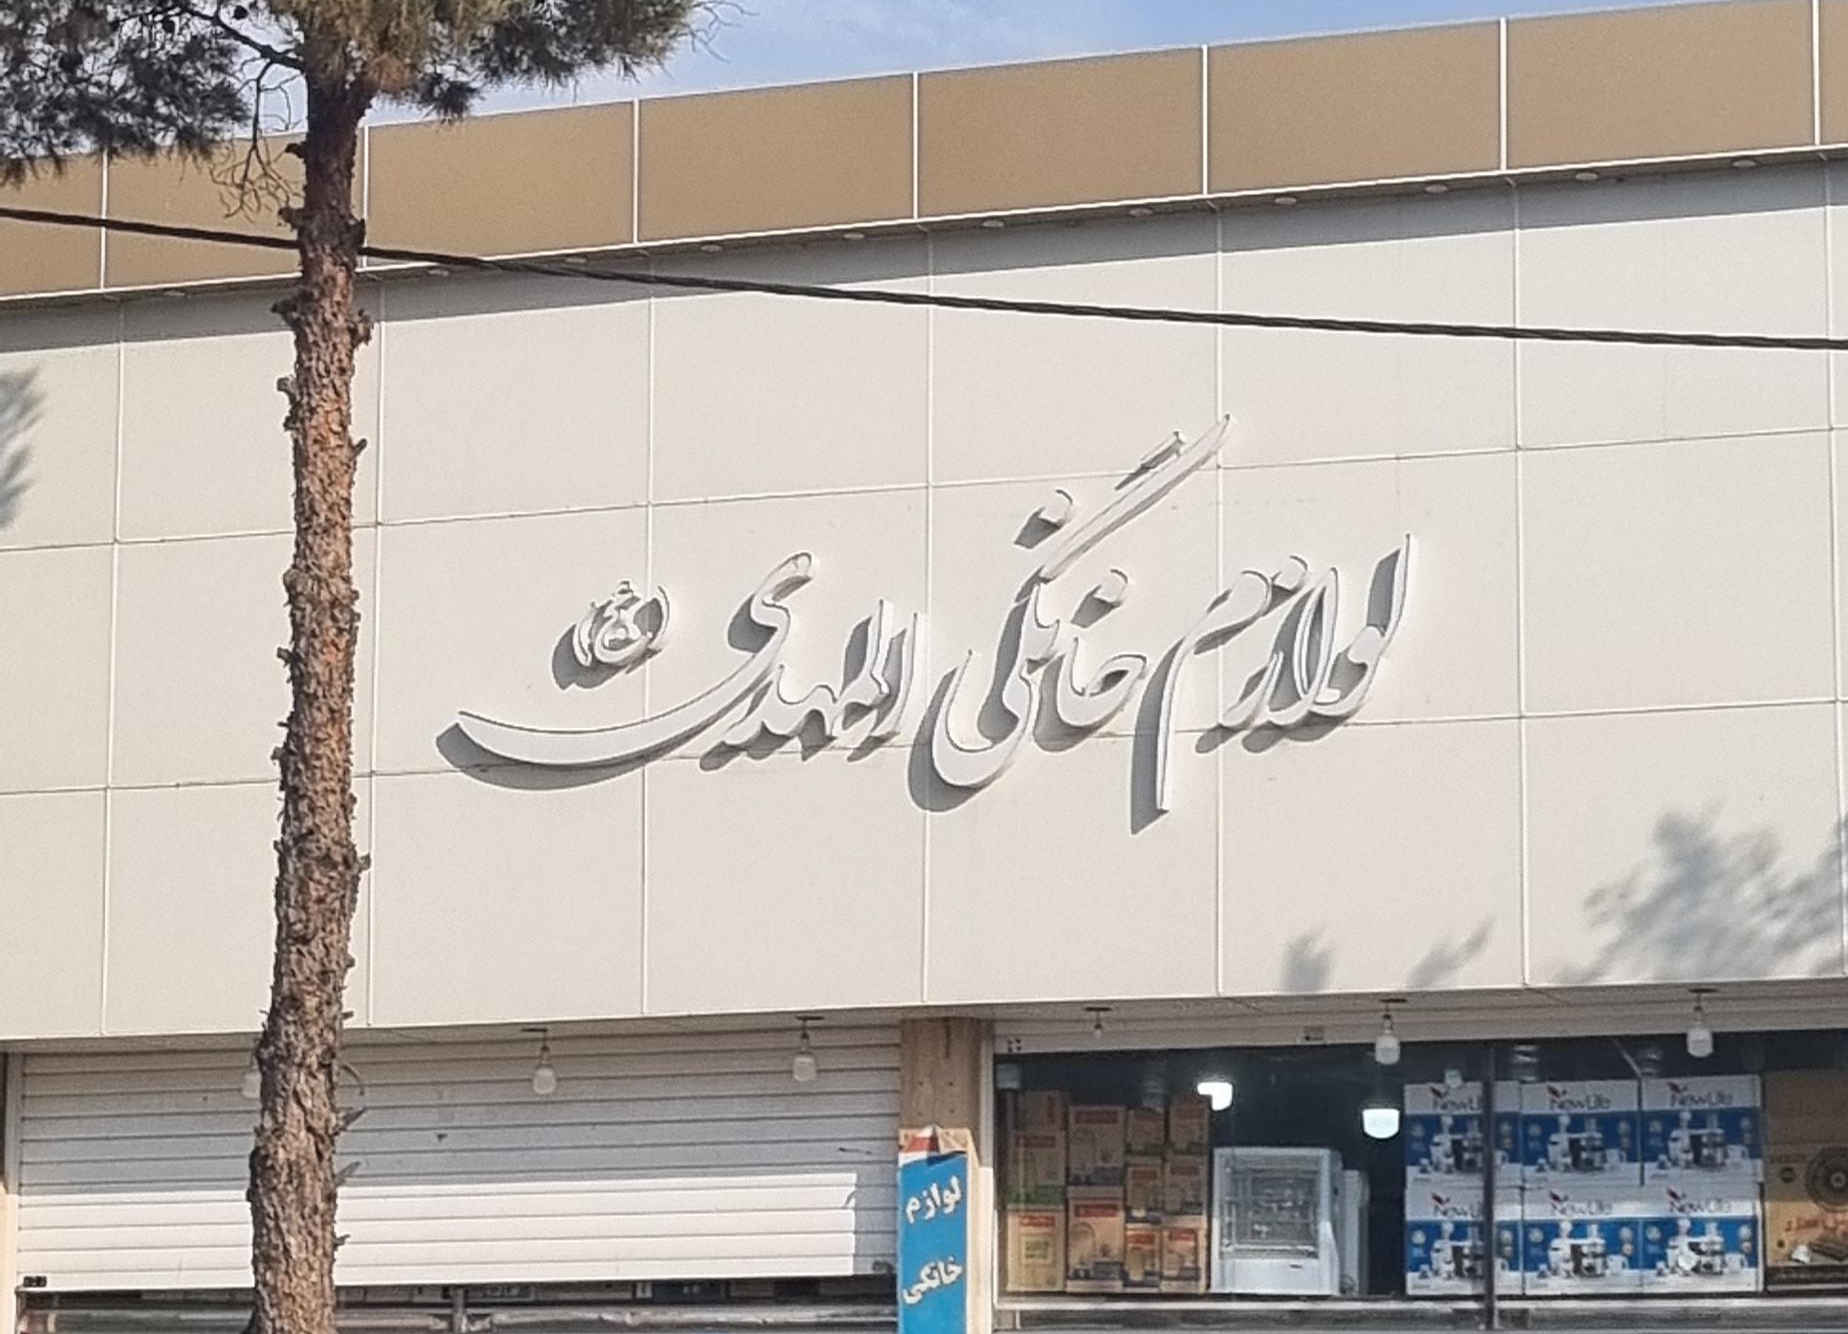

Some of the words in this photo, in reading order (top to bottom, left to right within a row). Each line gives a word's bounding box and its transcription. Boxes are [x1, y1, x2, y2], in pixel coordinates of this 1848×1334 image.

[452, 550, 928, 771] المهدی
[926, 412, 1238, 791] خانگی
[1148, 531, 1420, 815] لوازم
[902, 1254, 965, 1306] خانگی
[905, 1174, 964, 1225] لوازم
